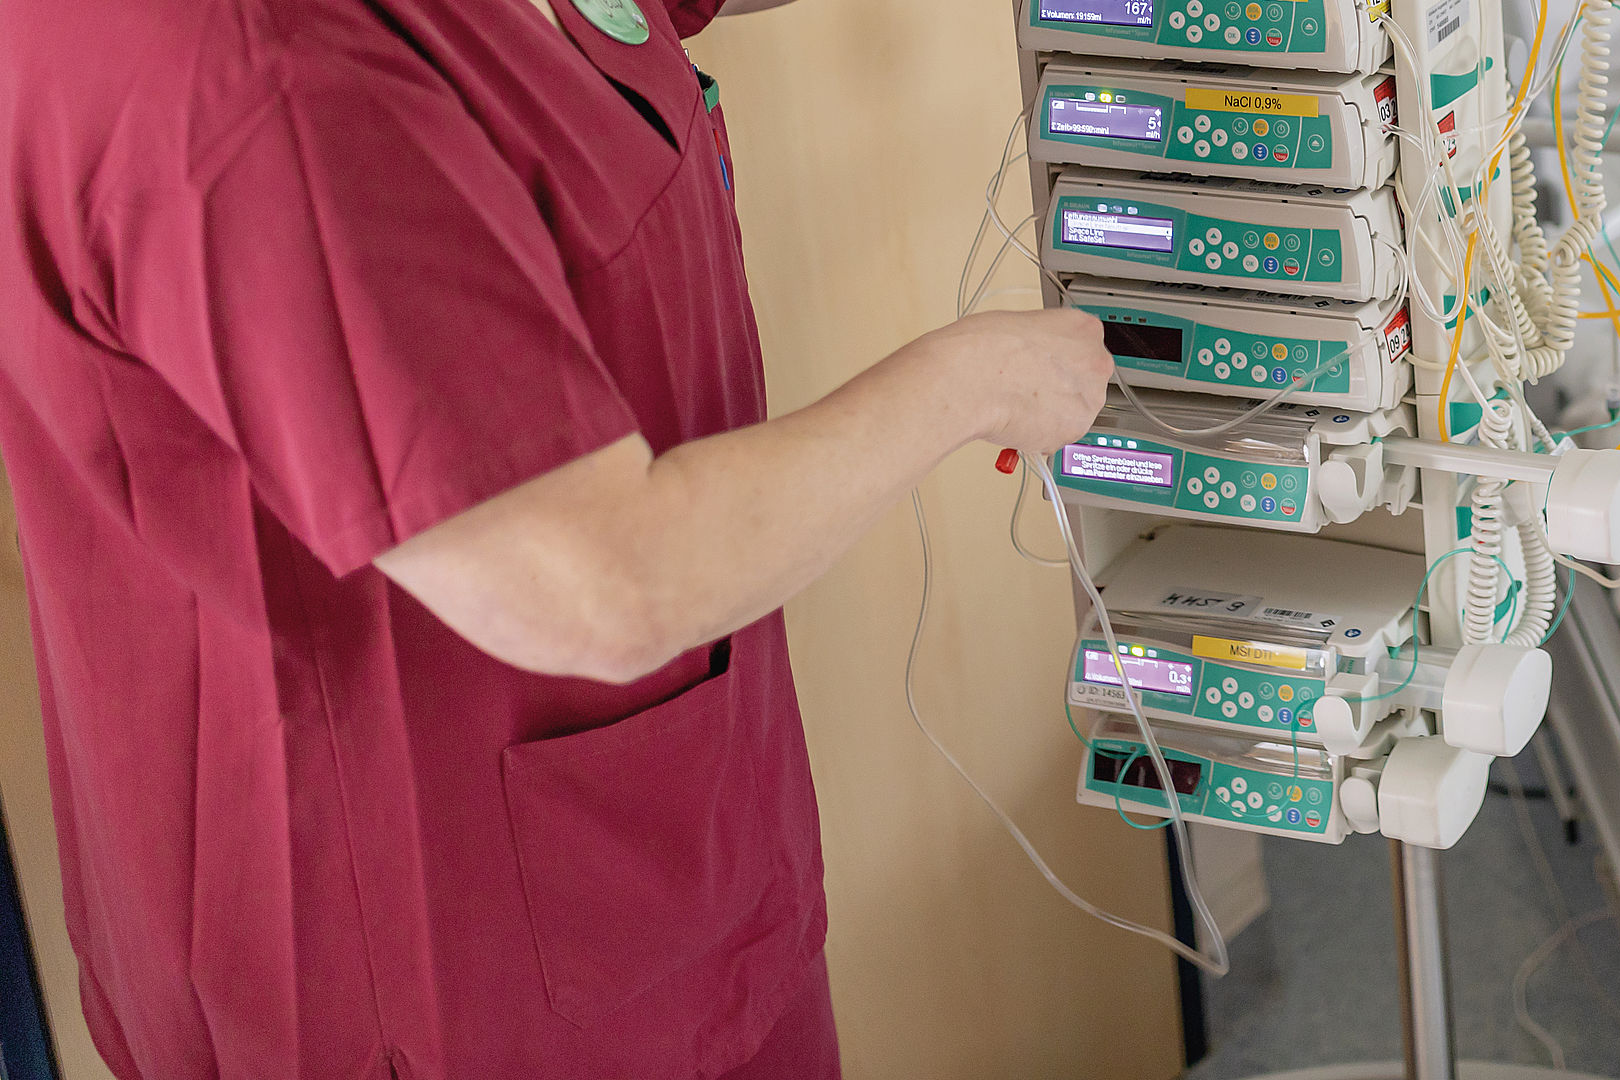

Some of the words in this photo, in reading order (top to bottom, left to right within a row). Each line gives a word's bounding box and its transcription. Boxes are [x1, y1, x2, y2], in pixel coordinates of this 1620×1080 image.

[1125, 1, 1148, 16] 167
[1224, 95, 1251, 108] NaCl
[1254, 96, 1282, 111] 0,9%
[1380, 103, 1391, 122] 03
[1390, 99, 1398, 117] 2
[1147, 117, 1157, 130] 5
[1389, 334, 1400, 354] 09
